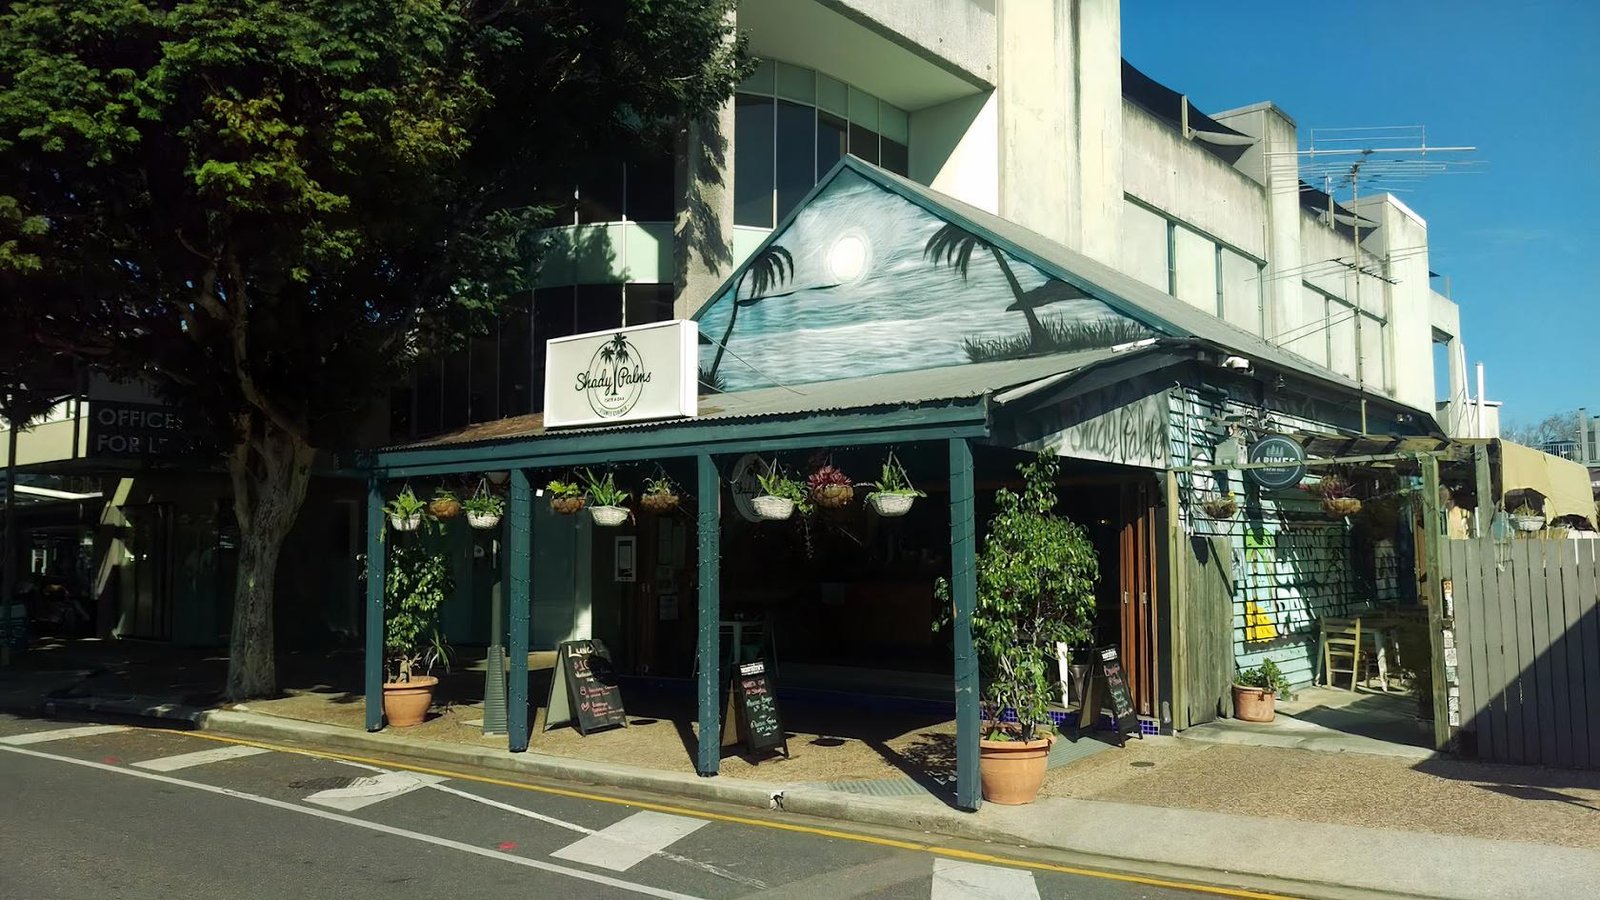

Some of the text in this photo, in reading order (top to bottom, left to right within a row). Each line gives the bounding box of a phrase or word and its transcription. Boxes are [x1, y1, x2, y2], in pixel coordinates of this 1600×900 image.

[575, 364, 652, 396] Shady Palms
[96, 434, 141, 454] FOR
